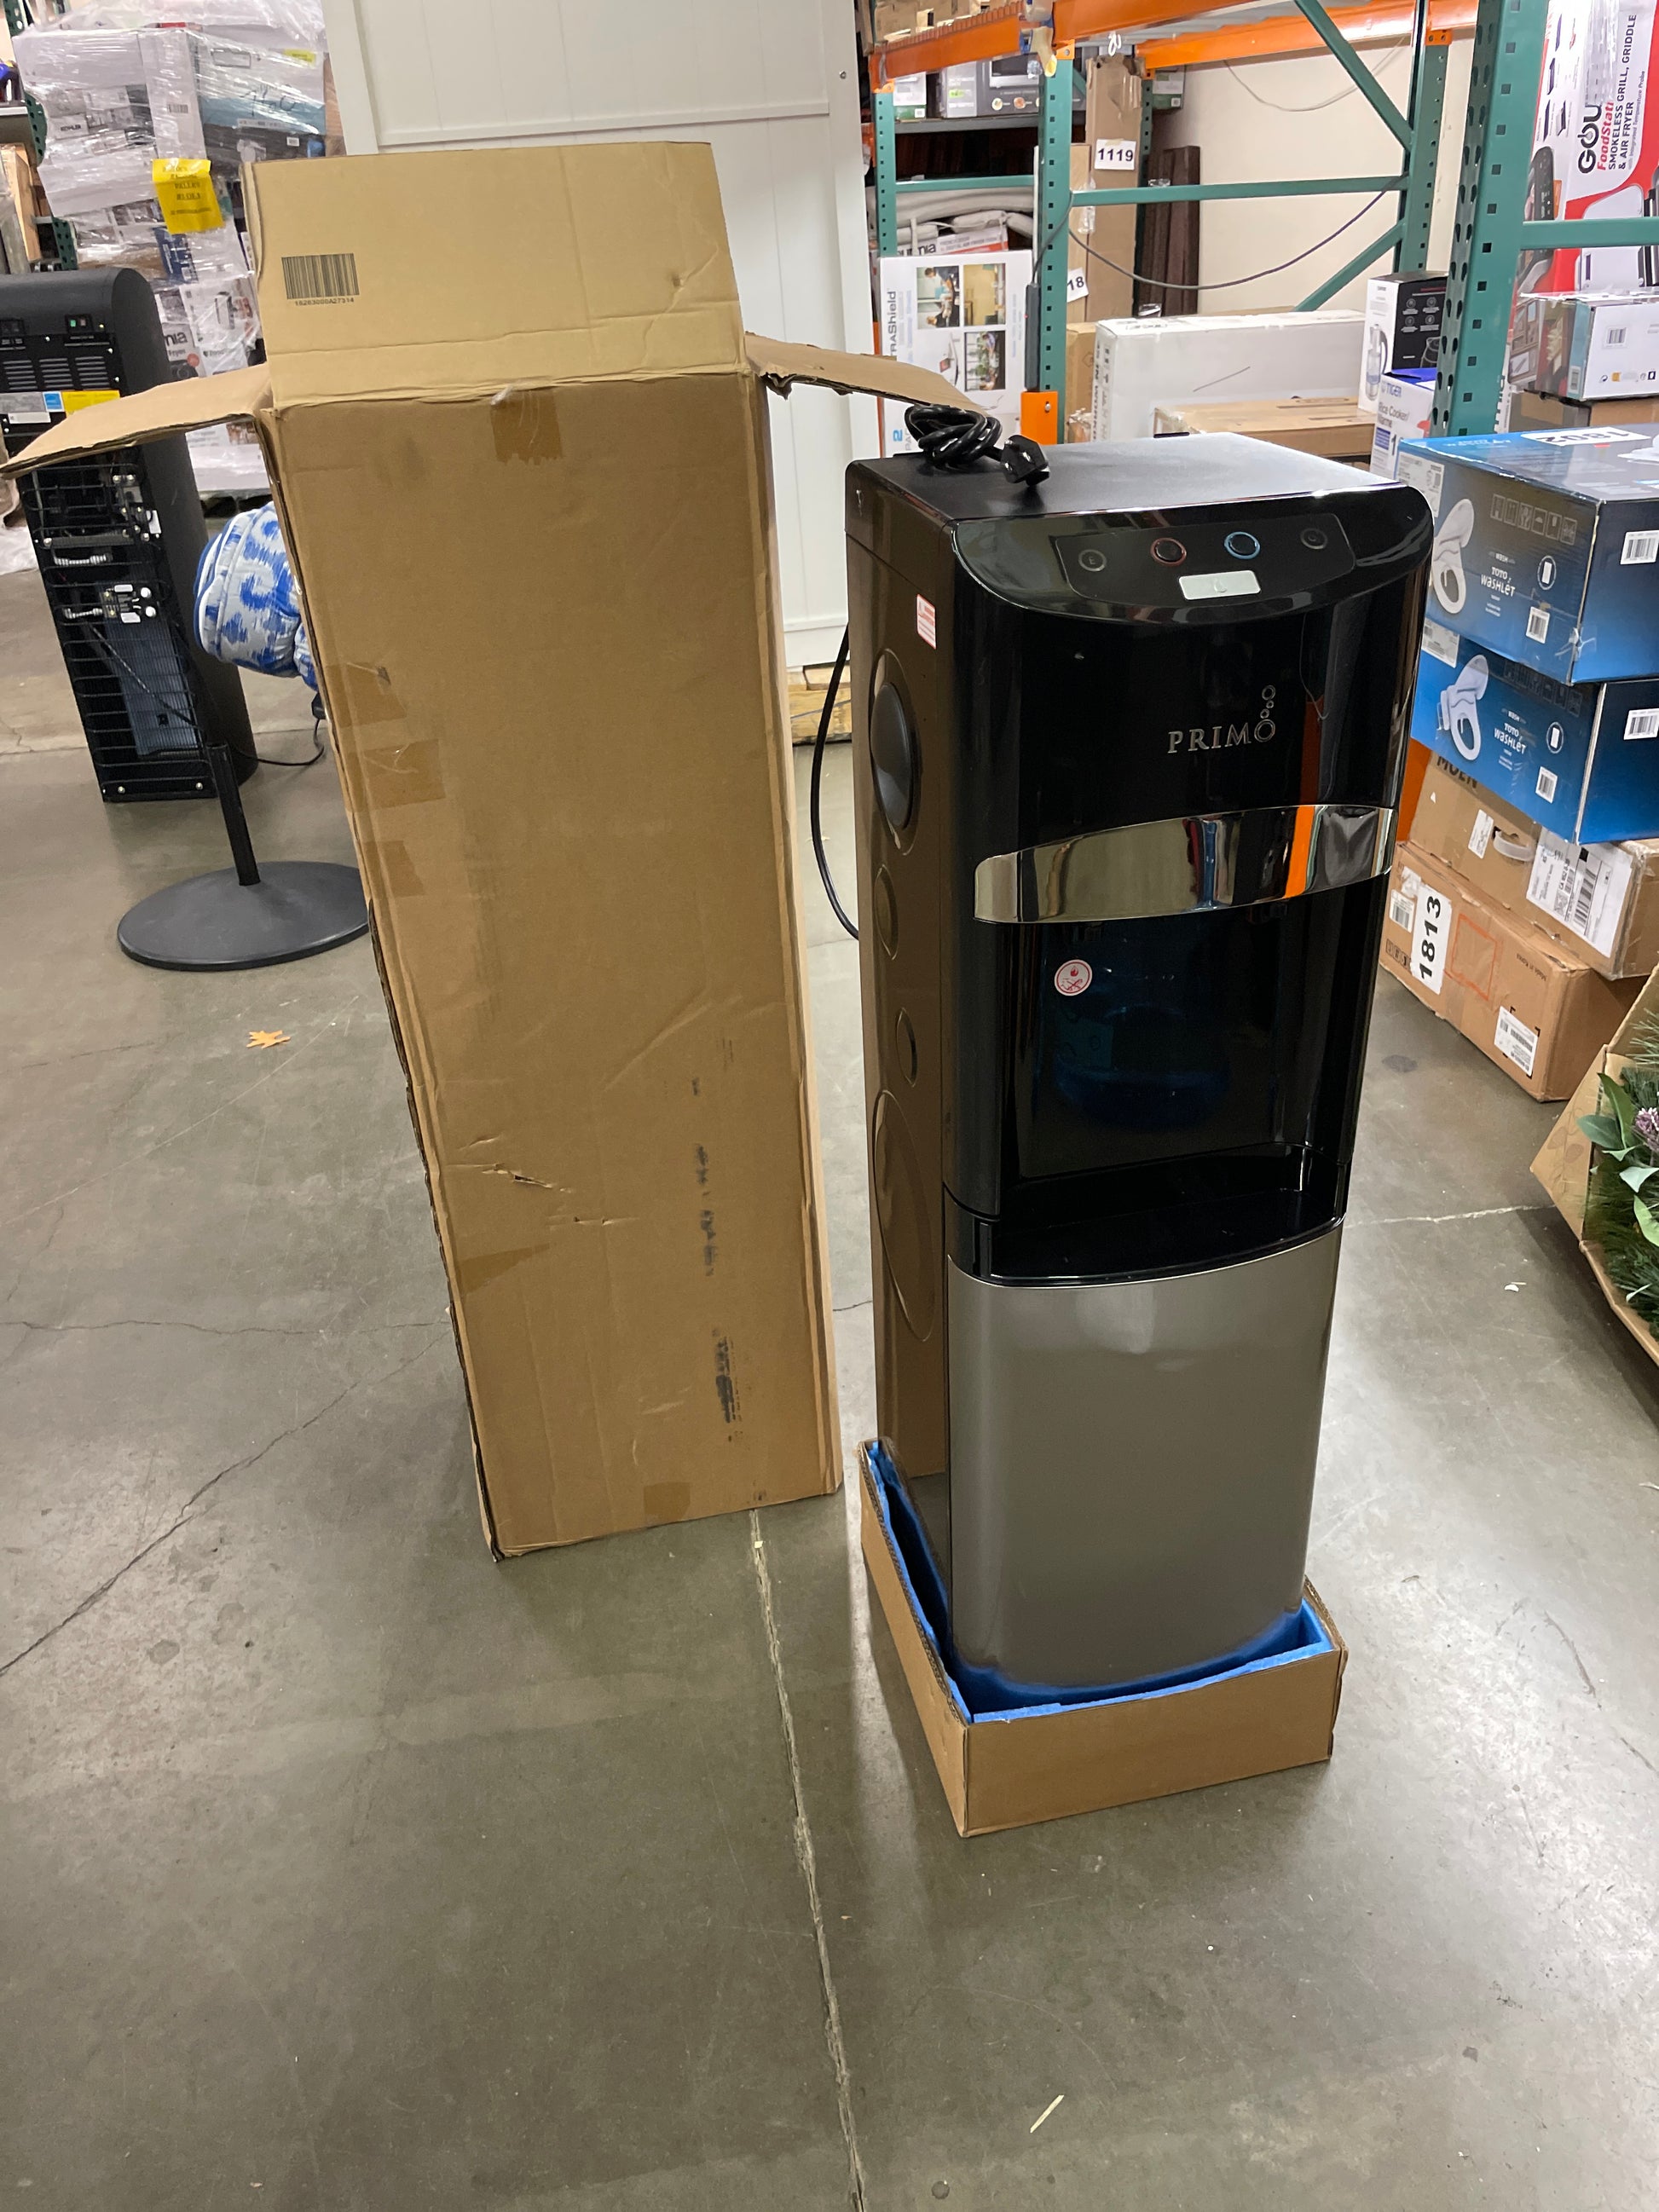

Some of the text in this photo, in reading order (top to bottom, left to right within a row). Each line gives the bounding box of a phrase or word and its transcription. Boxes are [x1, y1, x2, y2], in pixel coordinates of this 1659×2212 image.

[1609, 14, 1637, 170] SMOKELESS GRILL, GRIDDLE
[1597, 101, 1615, 170] FoodStati
[1618, 101, 1634, 170] & AIR FRYER
[1097, 147, 1134, 162] 1119
[1066, 276, 1084, 292] 18
[893, 429, 903, 442] 2
[1536, 431, 1629, 444] 1802
[1491, 566, 1508, 580] TOTO
[1167, 719, 1276, 754] PRIMO
[1504, 722, 1519, 737] TOTO
[1419, 896, 1441, 979] 1813
